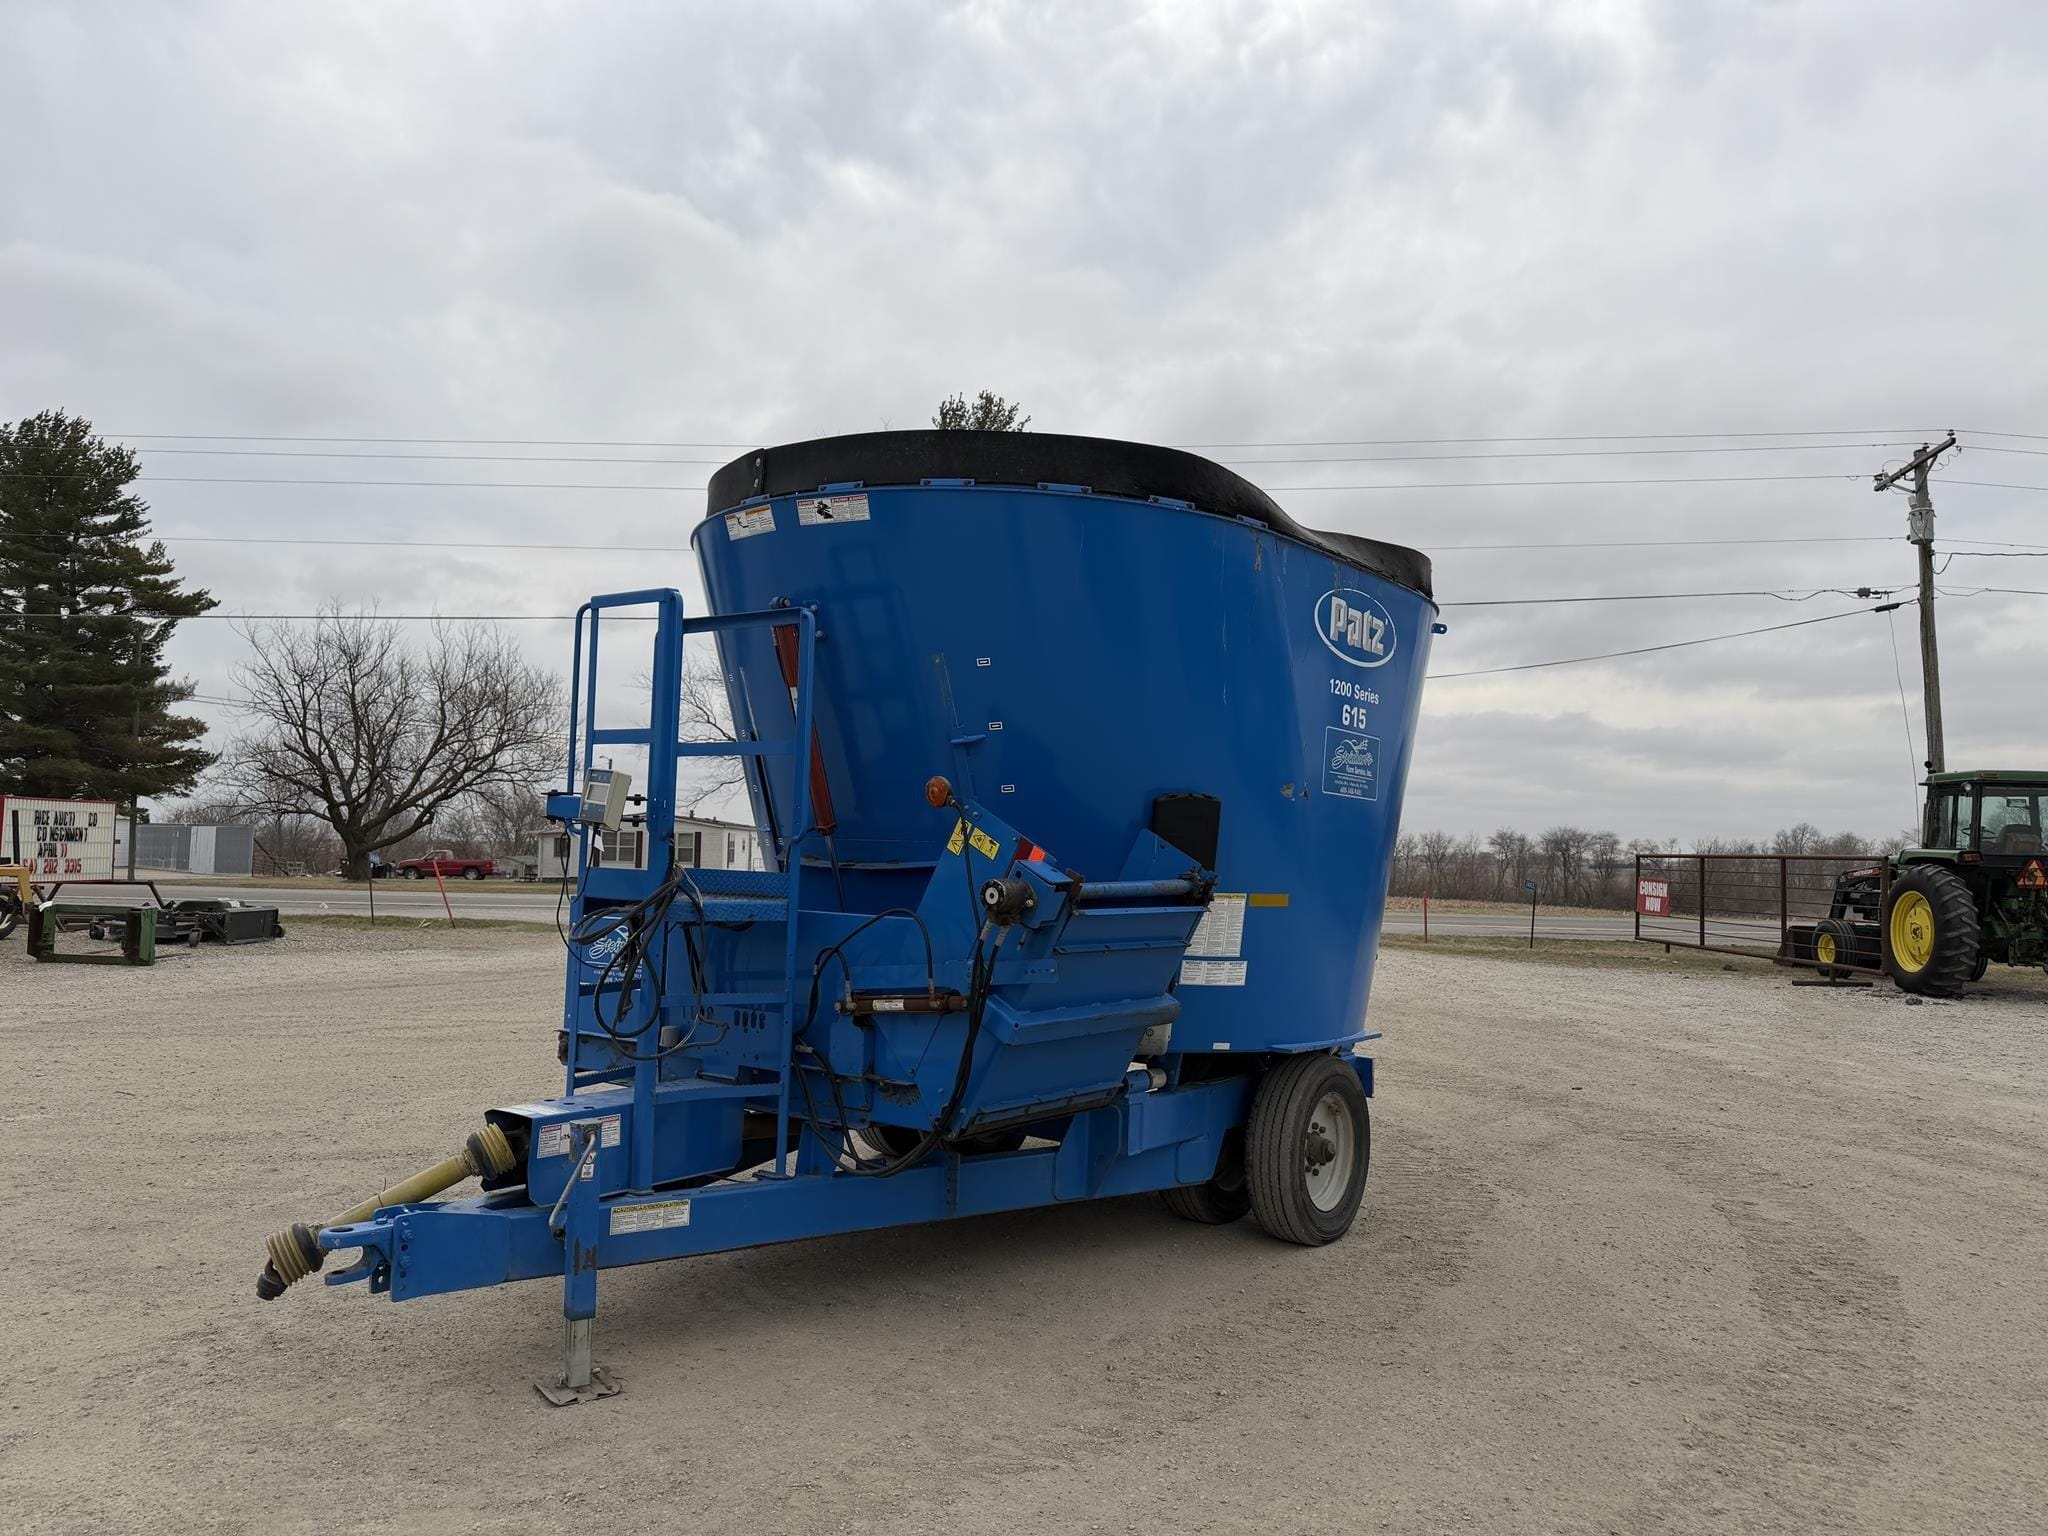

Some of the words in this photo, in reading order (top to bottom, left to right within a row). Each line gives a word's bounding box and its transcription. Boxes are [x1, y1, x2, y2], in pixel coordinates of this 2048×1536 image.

[1330, 596, 1385, 656] Patz
[1330, 678, 1352, 697] 1200
[1354, 684, 1380, 705] Series
[1342, 704, 1367, 730] 615
[37, 843, 58, 858] APRIL
[1640, 880, 1668, 897] CONSIGN
[1645, 896, 1661, 912] NOW
